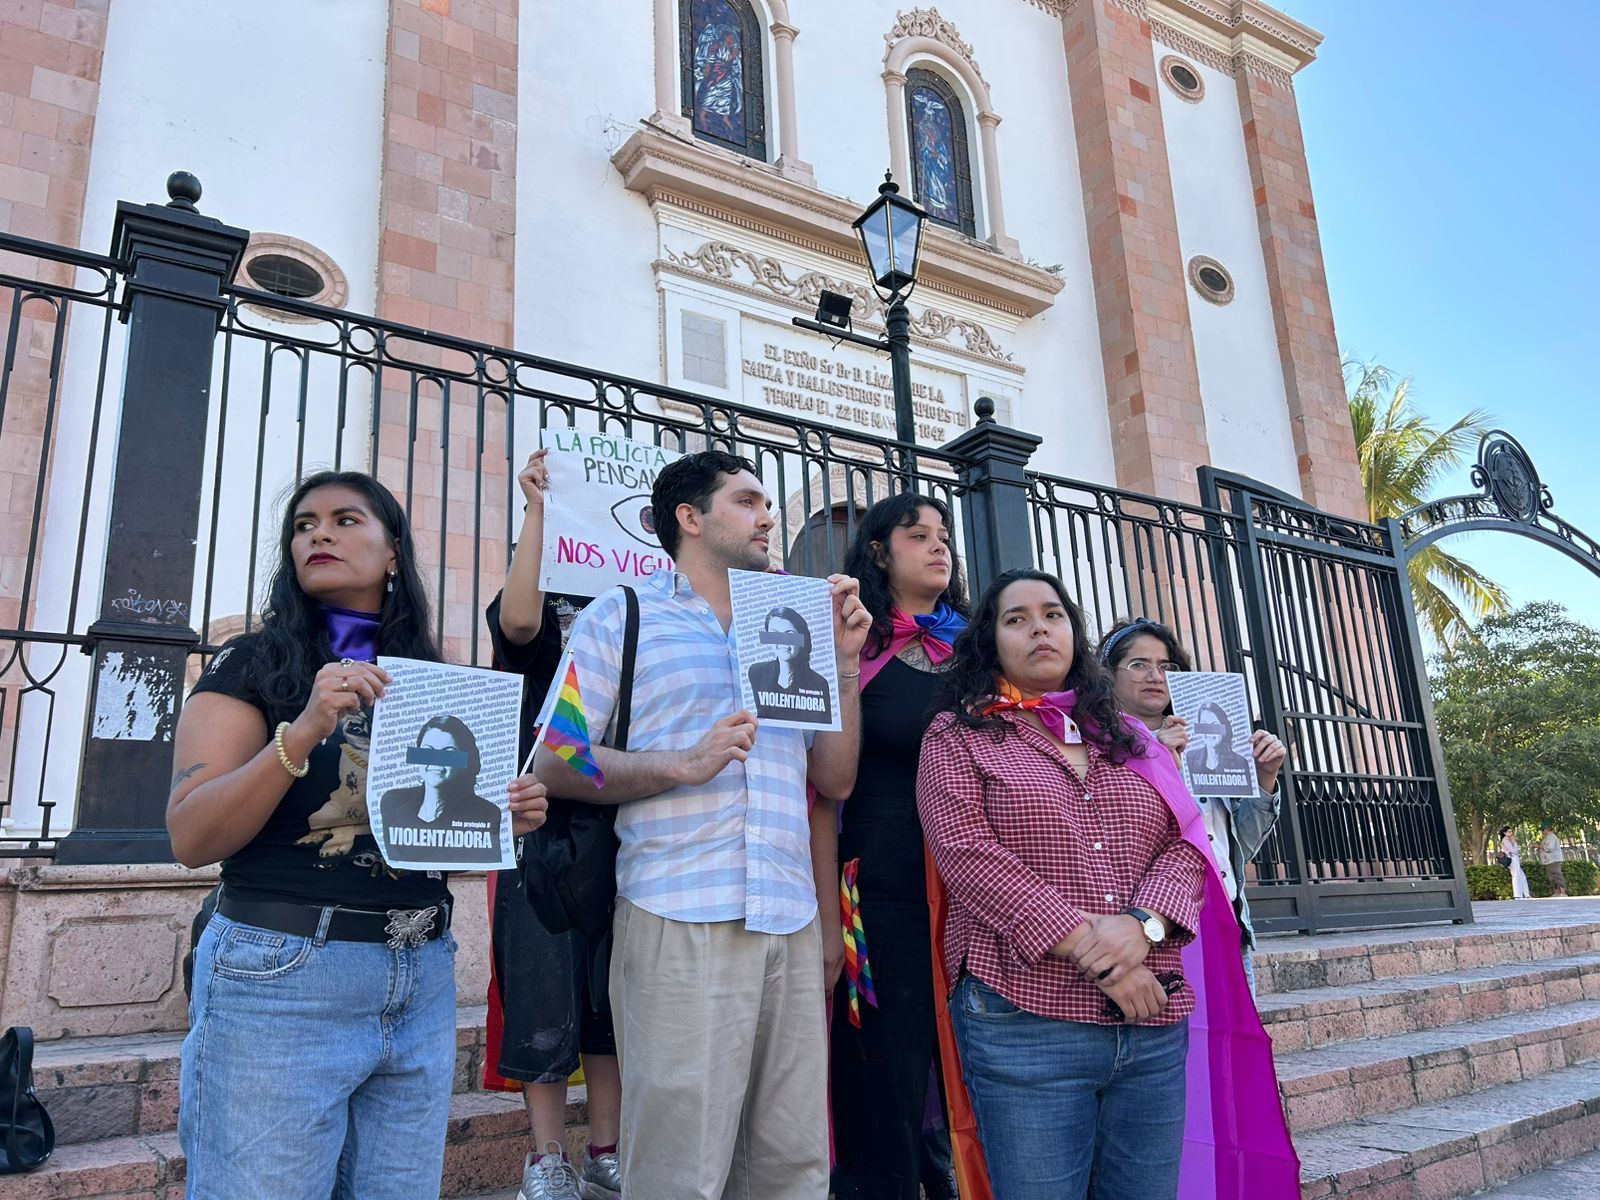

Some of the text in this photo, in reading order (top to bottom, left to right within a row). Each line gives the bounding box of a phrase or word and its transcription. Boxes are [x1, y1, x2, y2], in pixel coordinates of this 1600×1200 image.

[742, 358, 783, 384] GARZA
[786, 369, 795, 386] Y
[797, 372, 881, 407] BALLESTEROS
[763, 343, 782, 362] EL
[820, 358, 834, 374] Sr
[928, 386, 945, 403] LA
[762, 386, 814, 410] TEMPLO
[836, 403, 851, 421] 22
[853, 407, 869, 426] DE
[919, 423, 945, 442] 1842
[555, 433, 582, 452] LA
[557, 536, 605, 568] NOS
[757, 691, 826, 712] VIOLENTADORA
[1192, 773, 1248, 786] VIOLENTADORA
[388, 826, 493, 849] VIOLENTADORA
